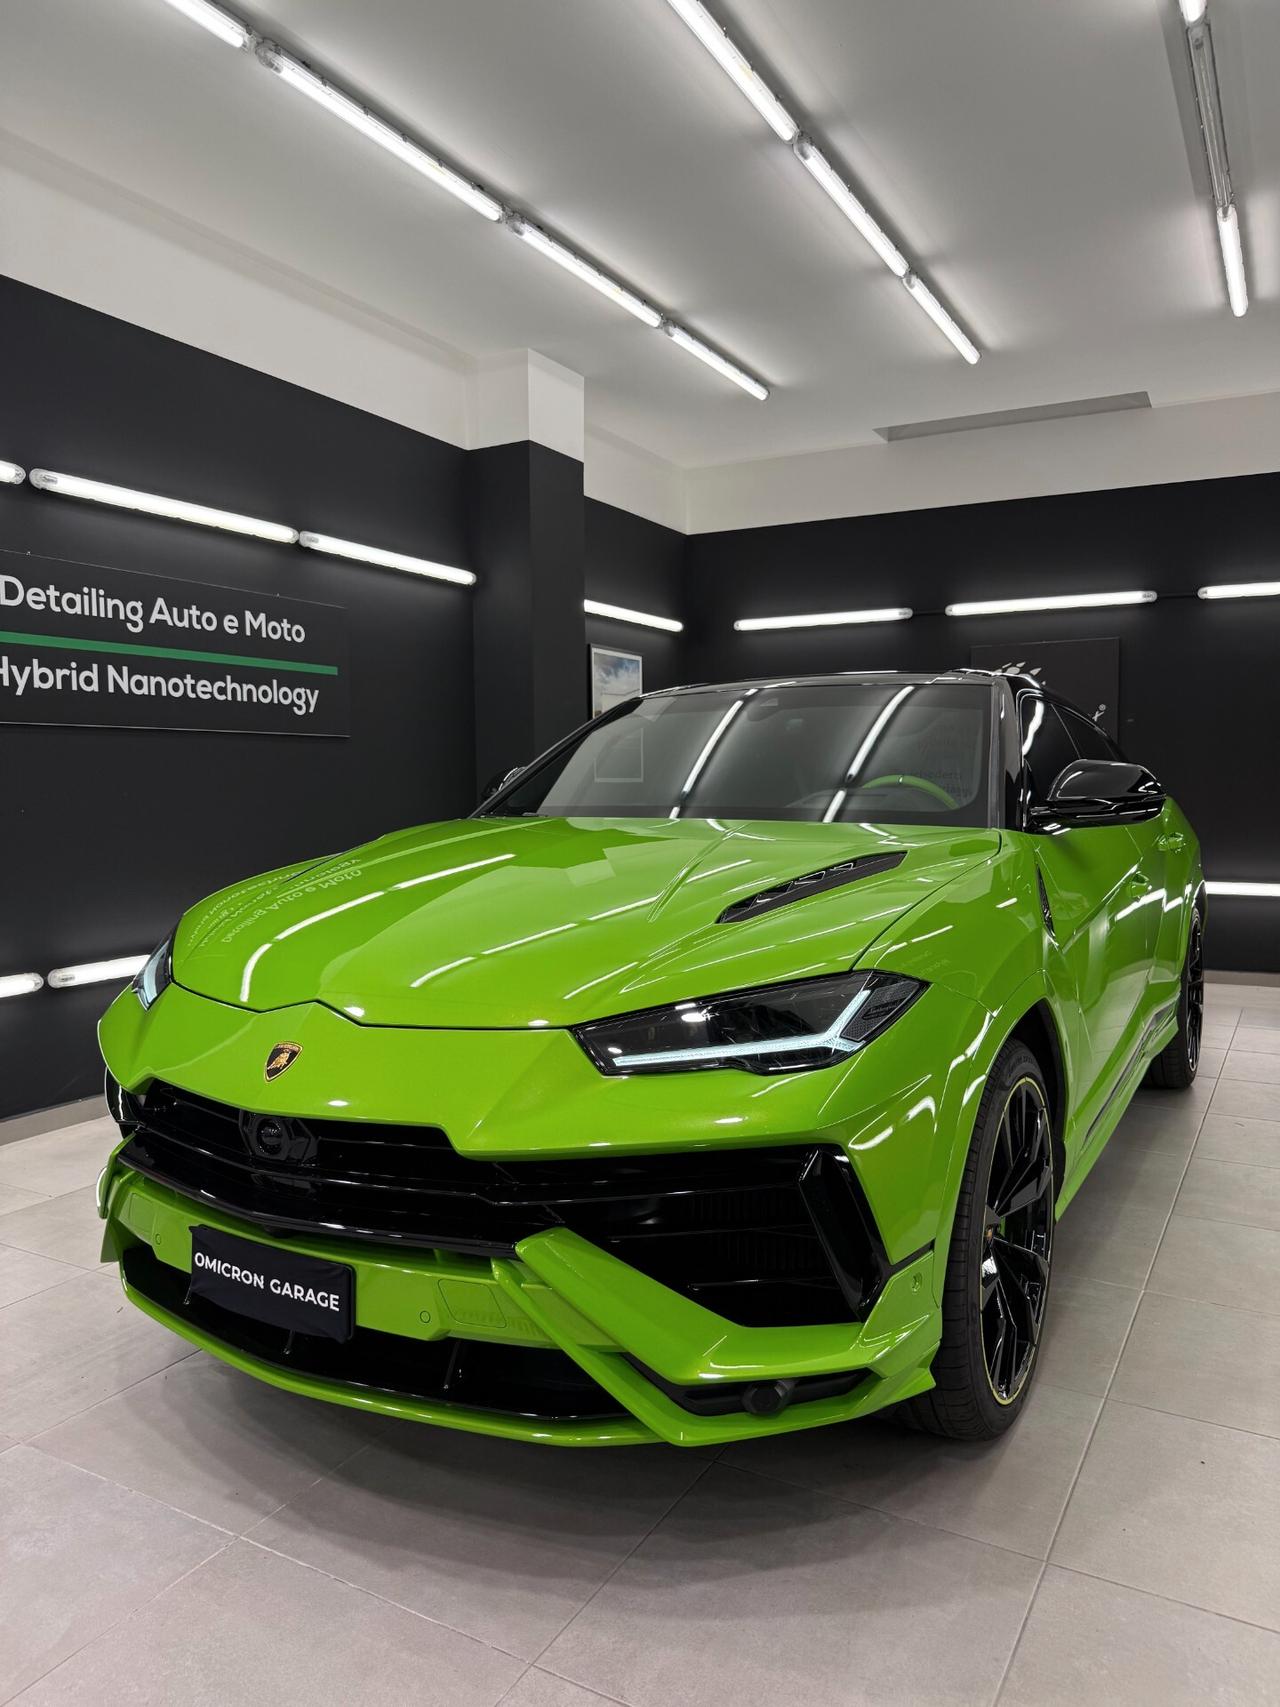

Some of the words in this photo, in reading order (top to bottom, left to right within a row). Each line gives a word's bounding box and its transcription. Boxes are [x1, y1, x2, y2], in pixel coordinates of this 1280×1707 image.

[0, 575, 144, 633] Detailing
[149, 597, 217, 631] Auto
[223, 615, 239, 635] e
[245, 610, 306, 643] Moto
[107, 665, 320, 716] Nanotechnology
[194, 1252, 265, 1289] OMICRON
[269, 1279, 340, 1312] GARAGE
